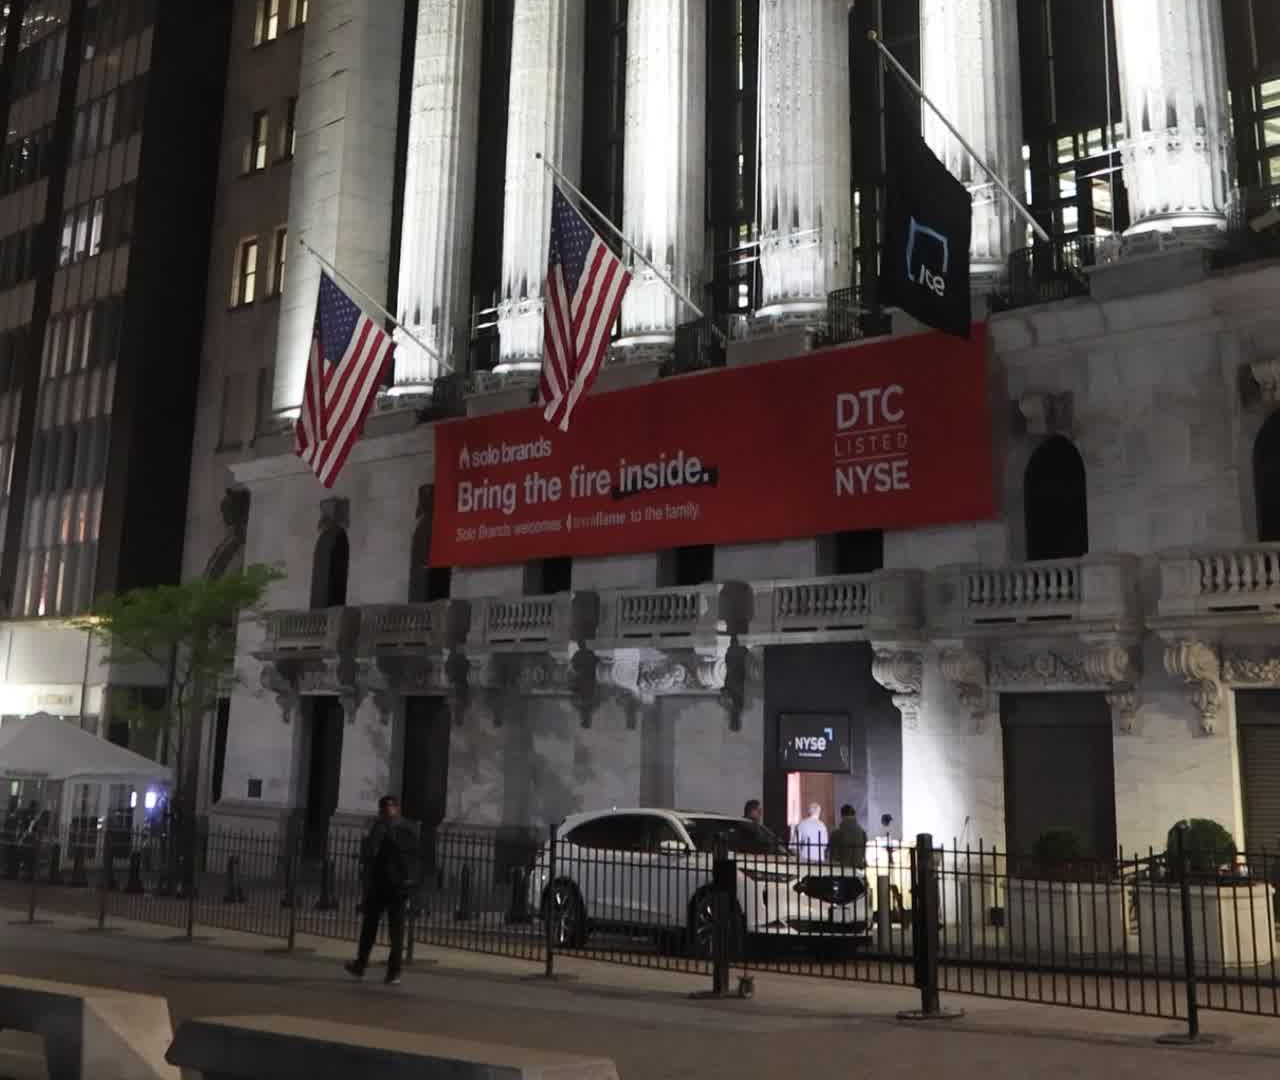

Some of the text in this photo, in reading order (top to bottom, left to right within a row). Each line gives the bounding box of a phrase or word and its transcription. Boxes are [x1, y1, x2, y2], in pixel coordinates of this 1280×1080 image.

[836, 384, 904, 430] DTC
[472, 435, 552, 467] solo brands
[834, 431, 908, 457] LISTED
[457, 449, 709, 515] Bring the fire inside.
[835, 460, 911, 497] NYSE
[630, 508, 642, 523] to
[644, 505, 663, 521] the
